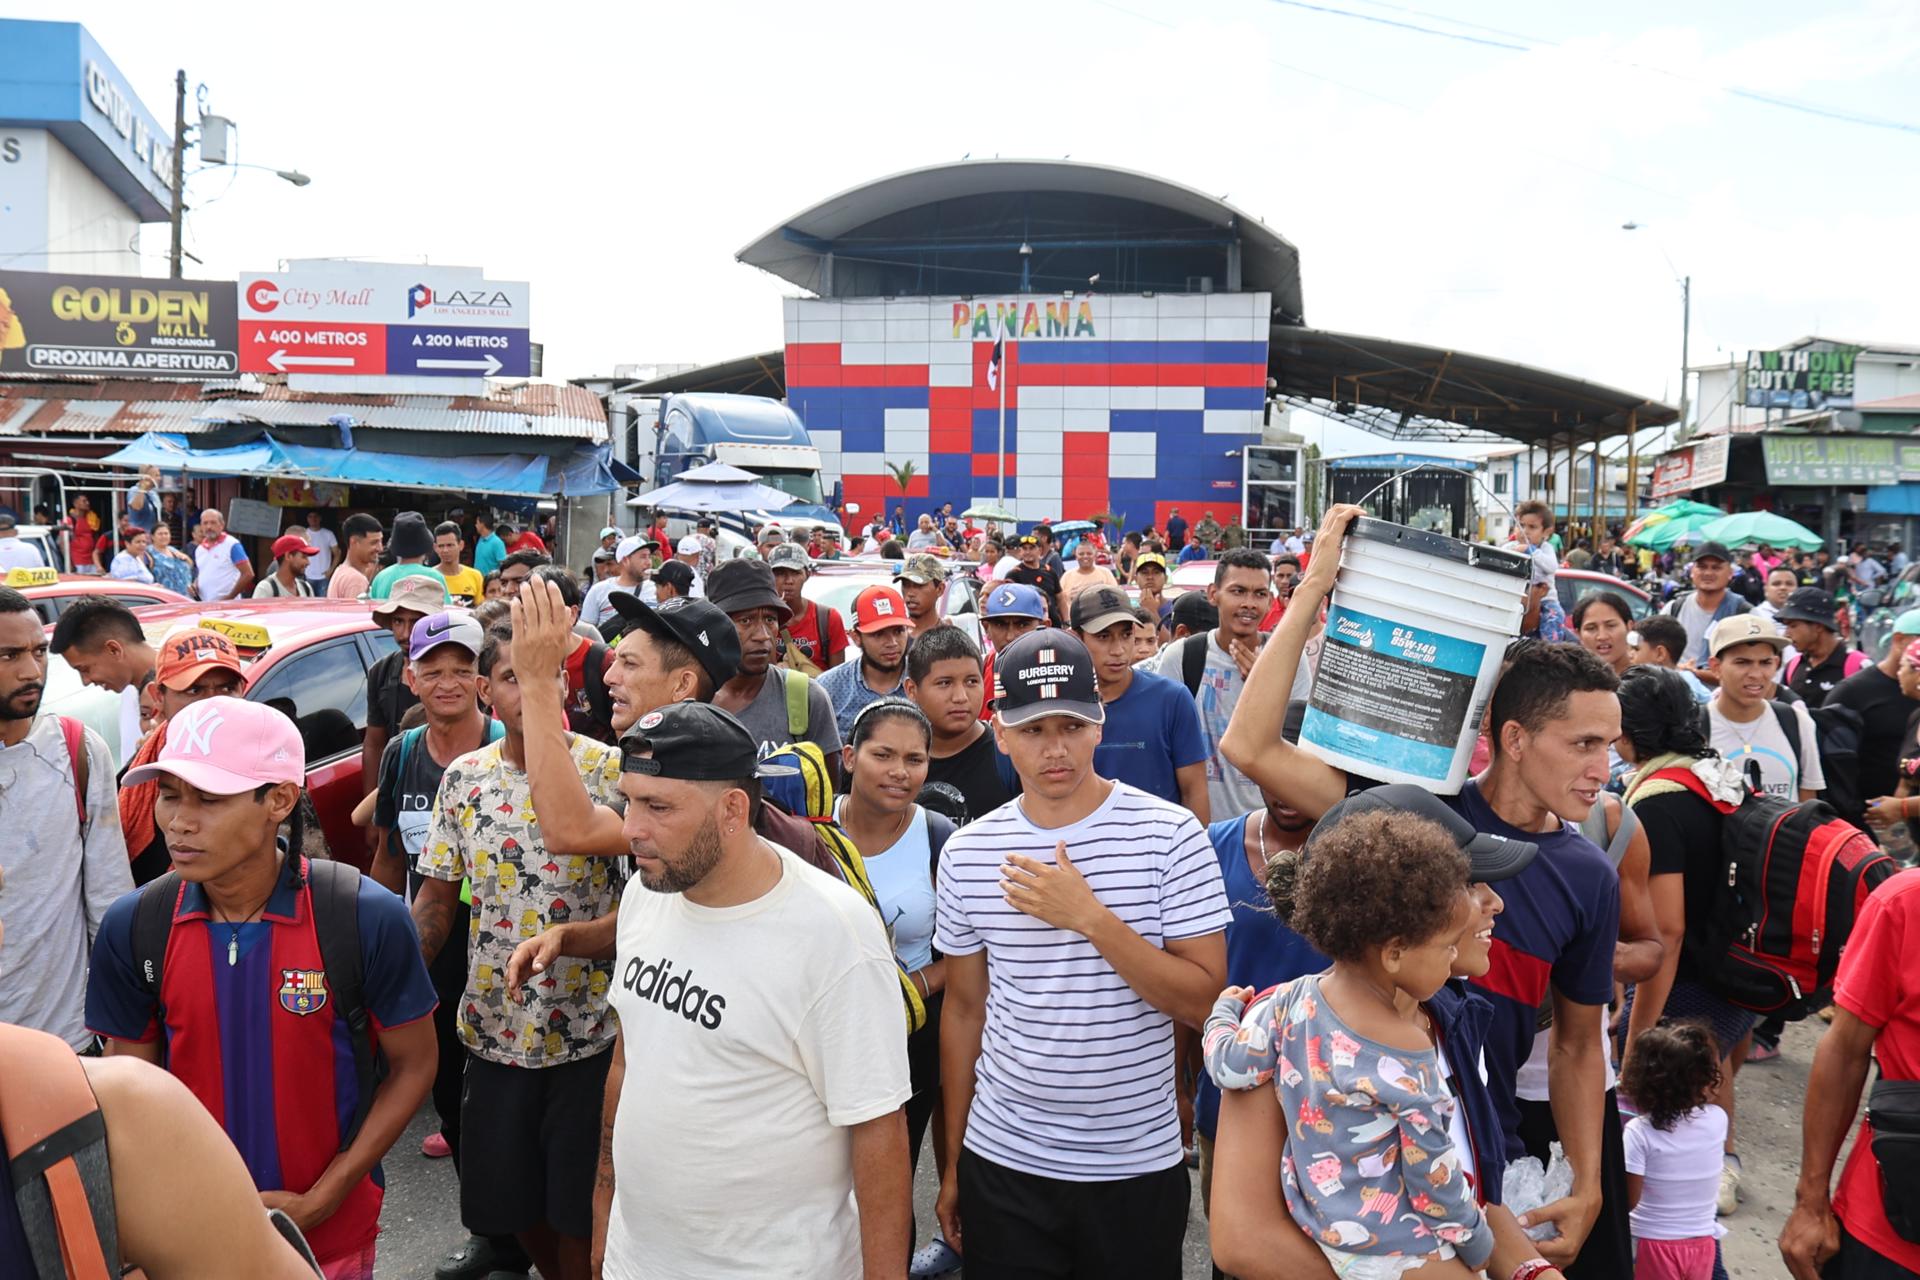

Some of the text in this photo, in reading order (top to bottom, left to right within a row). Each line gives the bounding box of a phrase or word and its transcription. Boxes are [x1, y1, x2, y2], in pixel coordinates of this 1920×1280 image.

[52, 285, 208, 325] GOLDEN
[283, 287, 374, 309] City Mall
[158, 322, 208, 337] MALL
[952, 301, 1096, 339] PANAMA
[254, 330, 368, 345] A 400 METROS
[412, 335, 508, 348] A 200 METROS
[34, 349, 229, 370] PROXIMA APERTURA
[1748, 351, 1854, 373] ANTHONY
[1747, 371, 1853, 393] DUTY FREE
[31, 571, 55, 582] TAXI
[219, 622, 261, 640] Taxi
[176, 635, 229, 660] NIKE
[1018, 664, 1074, 680] BURBERRY
[623, 956, 727, 1031] adidas
